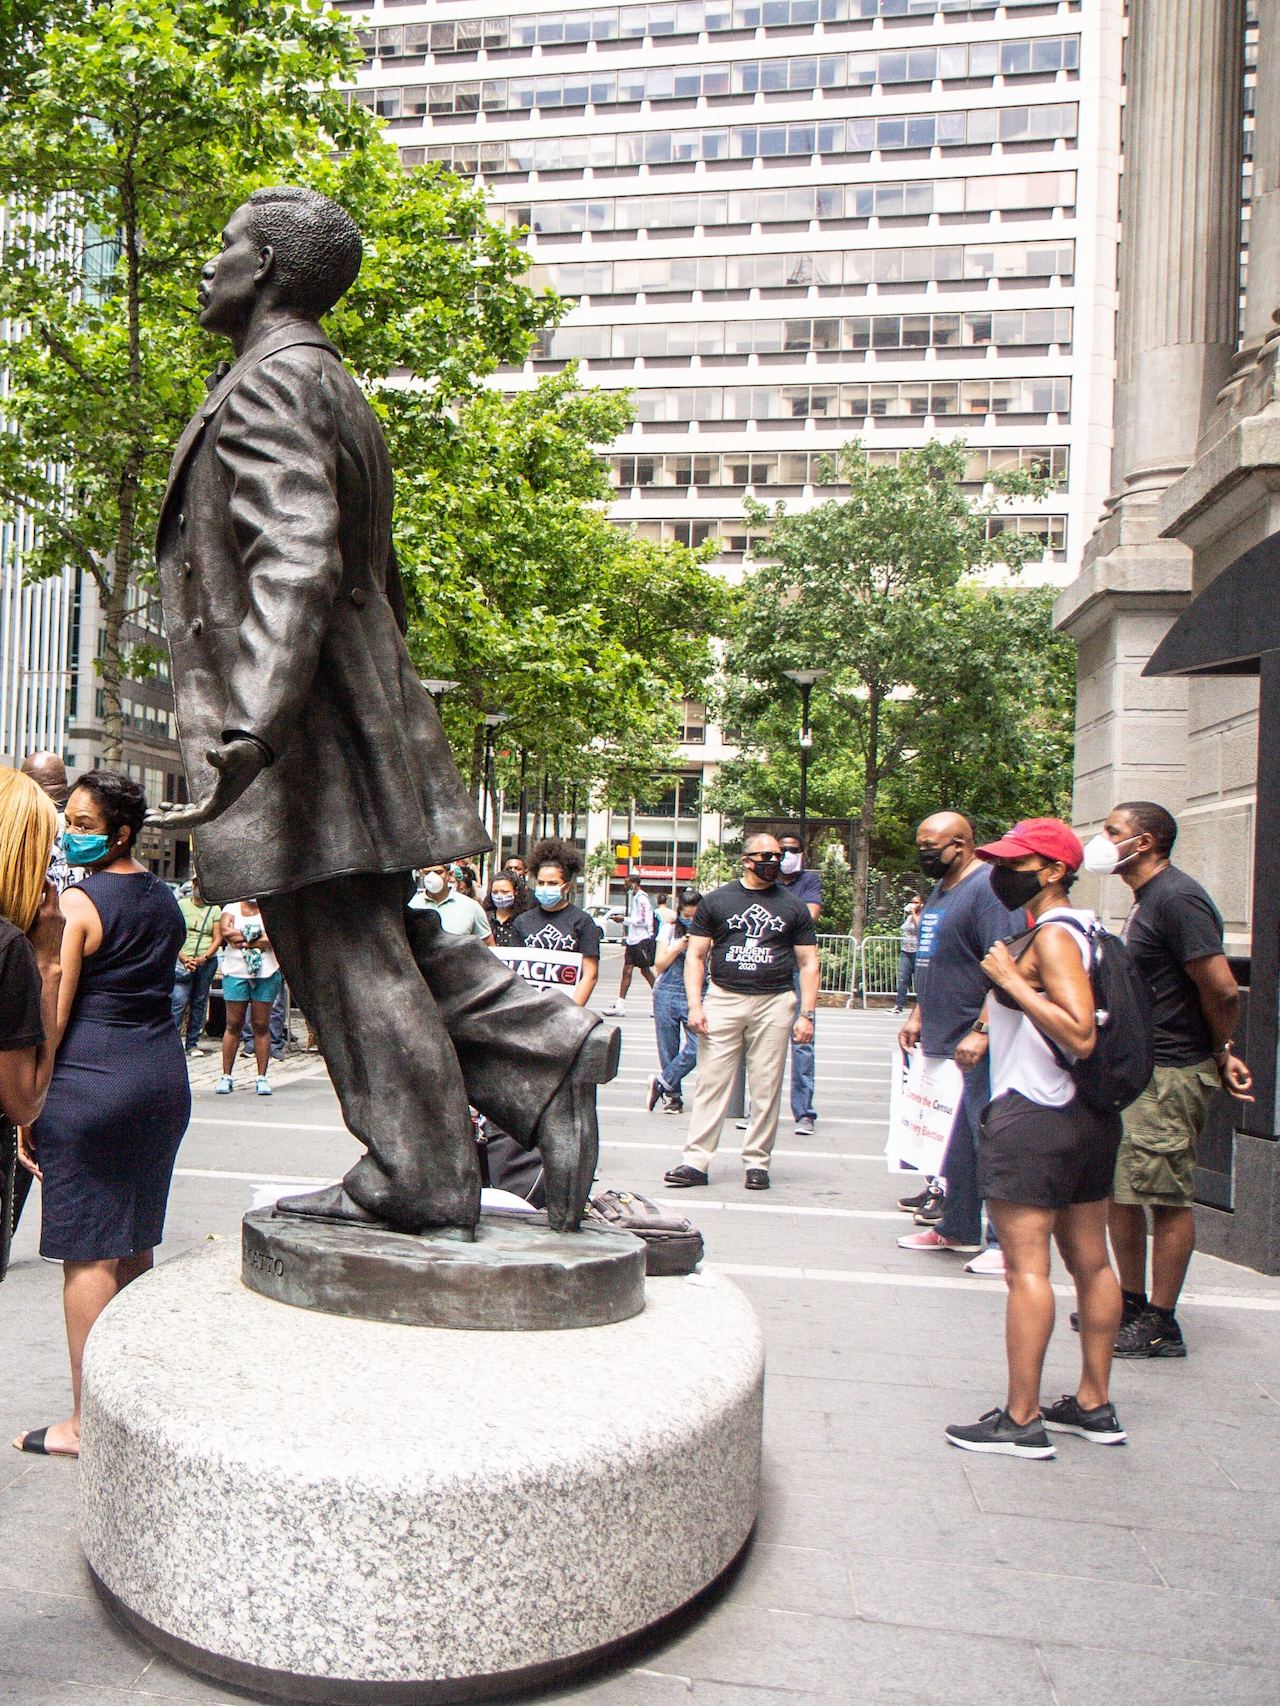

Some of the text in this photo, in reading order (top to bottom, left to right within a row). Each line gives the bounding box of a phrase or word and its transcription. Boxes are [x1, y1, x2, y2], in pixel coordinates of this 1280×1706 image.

[639, 867, 674, 877] Santande
[728, 945, 772, 955] STUDENT
[725, 953, 774, 963] BLACKOUT
[738, 962, 757, 971] 2020
[933, 1099, 953, 1115] Census
